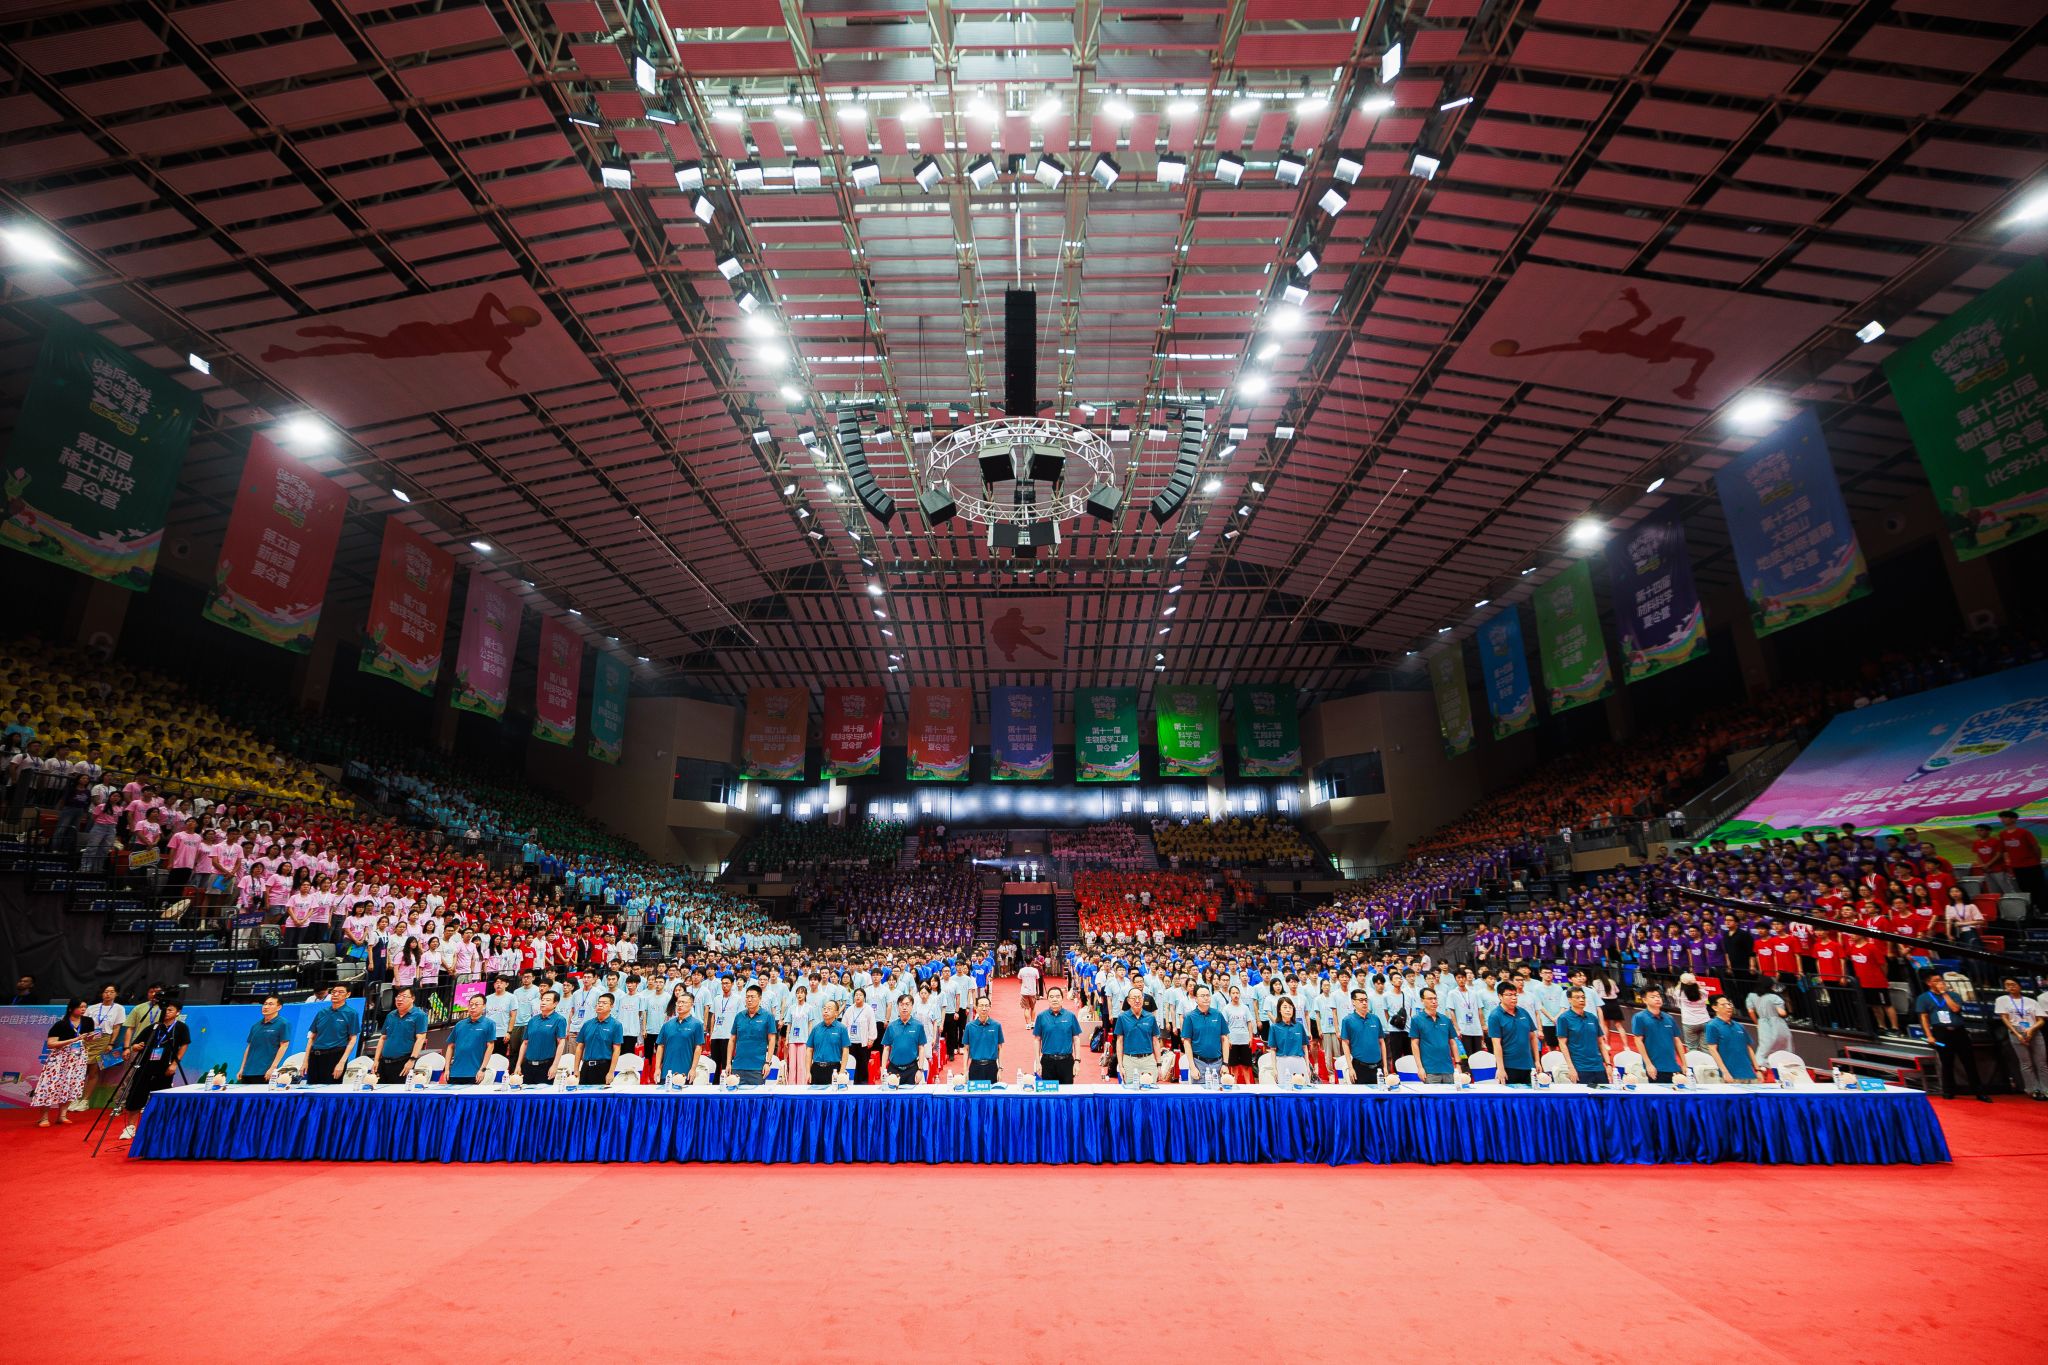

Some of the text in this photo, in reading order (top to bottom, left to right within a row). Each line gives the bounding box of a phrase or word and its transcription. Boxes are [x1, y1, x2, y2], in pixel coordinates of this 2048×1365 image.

[1956, 373, 2039, 429] 第十五届
[1955, 390, 2048, 452] 物理与化学
[1982, 420, 2048, 465] 夏令营
[75, 432, 134, 472] 第五届
[58, 447, 136, 495] 稀土科技
[61, 472, 121, 511] 夏令营
[1760, 495, 1812, 534] 第十五届
[262, 528, 302, 558] 第五届
[1779, 549, 1821, 580] 夏令营
[250, 560, 291, 589] 夏令营
[1635, 574, 1672, 605] 第十四届
[1642, 604, 1672, 630] 夏令营
[400, 621, 425, 644] 夏令营
[842, 724, 865, 733] 第十届
[925, 725, 955, 734] 第十一届
[1007, 725, 1037, 734] 第十一届
[1091, 726, 1121, 735] 第十一届
[1173, 722, 1203, 732] 第十一届
[1252, 722, 1282, 731] 第十二届
[841, 741, 863, 751] 夏令营
[1085, 735, 1129, 744] 生物医学工程
[1179, 740, 1202, 748] 夏令营
[1258, 739, 1281, 748] 夏令营
[927, 742, 950, 752] 夏令营
[1011, 743, 1034, 752] 夏令营
[1096, 744, 1119, 753] 夏令营
[1014, 902, 1029, 915] J1
